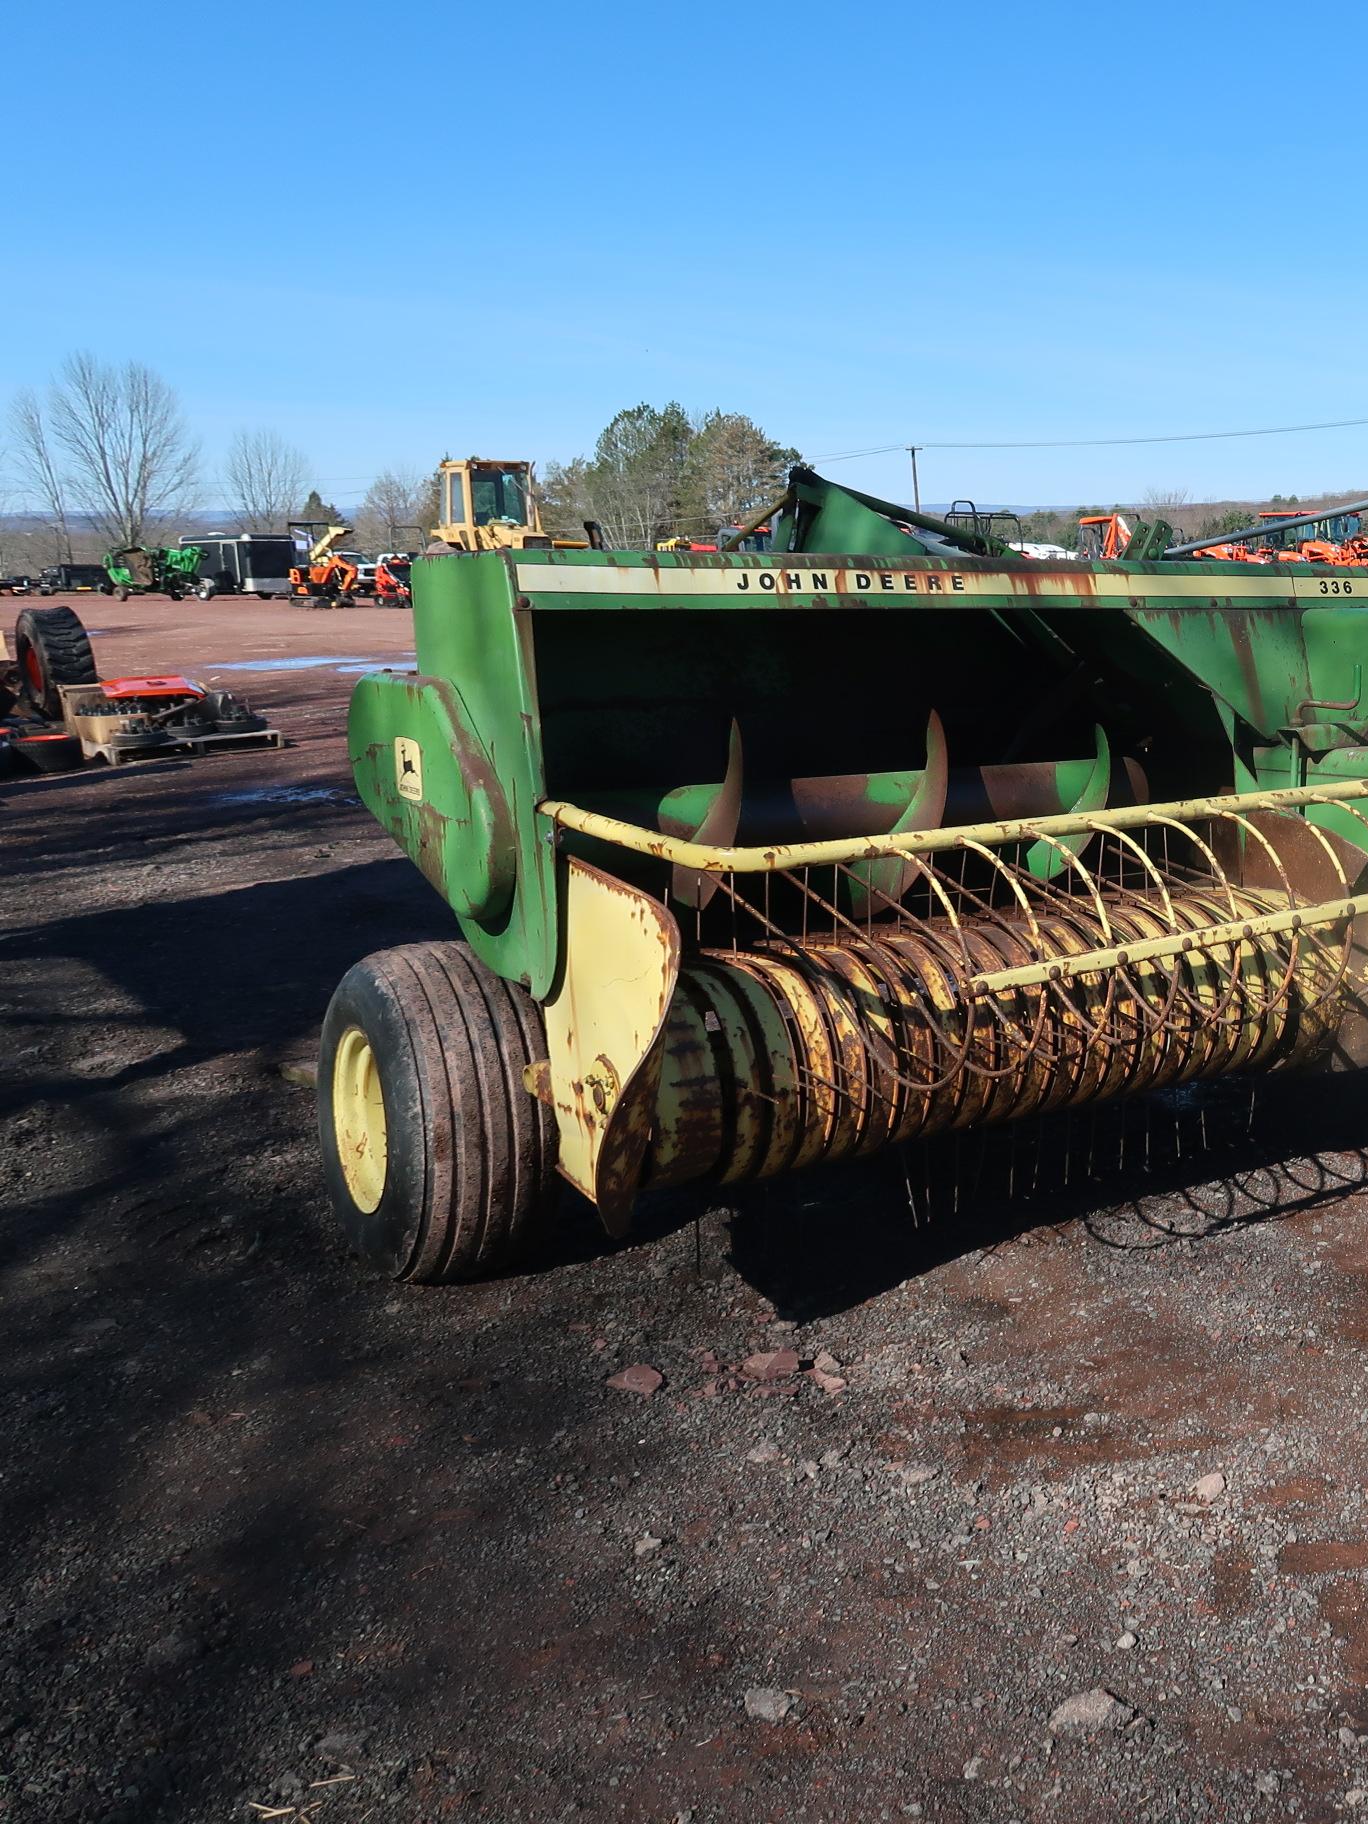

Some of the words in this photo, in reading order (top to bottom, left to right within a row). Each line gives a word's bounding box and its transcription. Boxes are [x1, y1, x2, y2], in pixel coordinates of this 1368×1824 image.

[736, 572, 828, 591] JOHN
[856, 572, 965, 592] DEERE
[1319, 580, 1353, 595] 336
